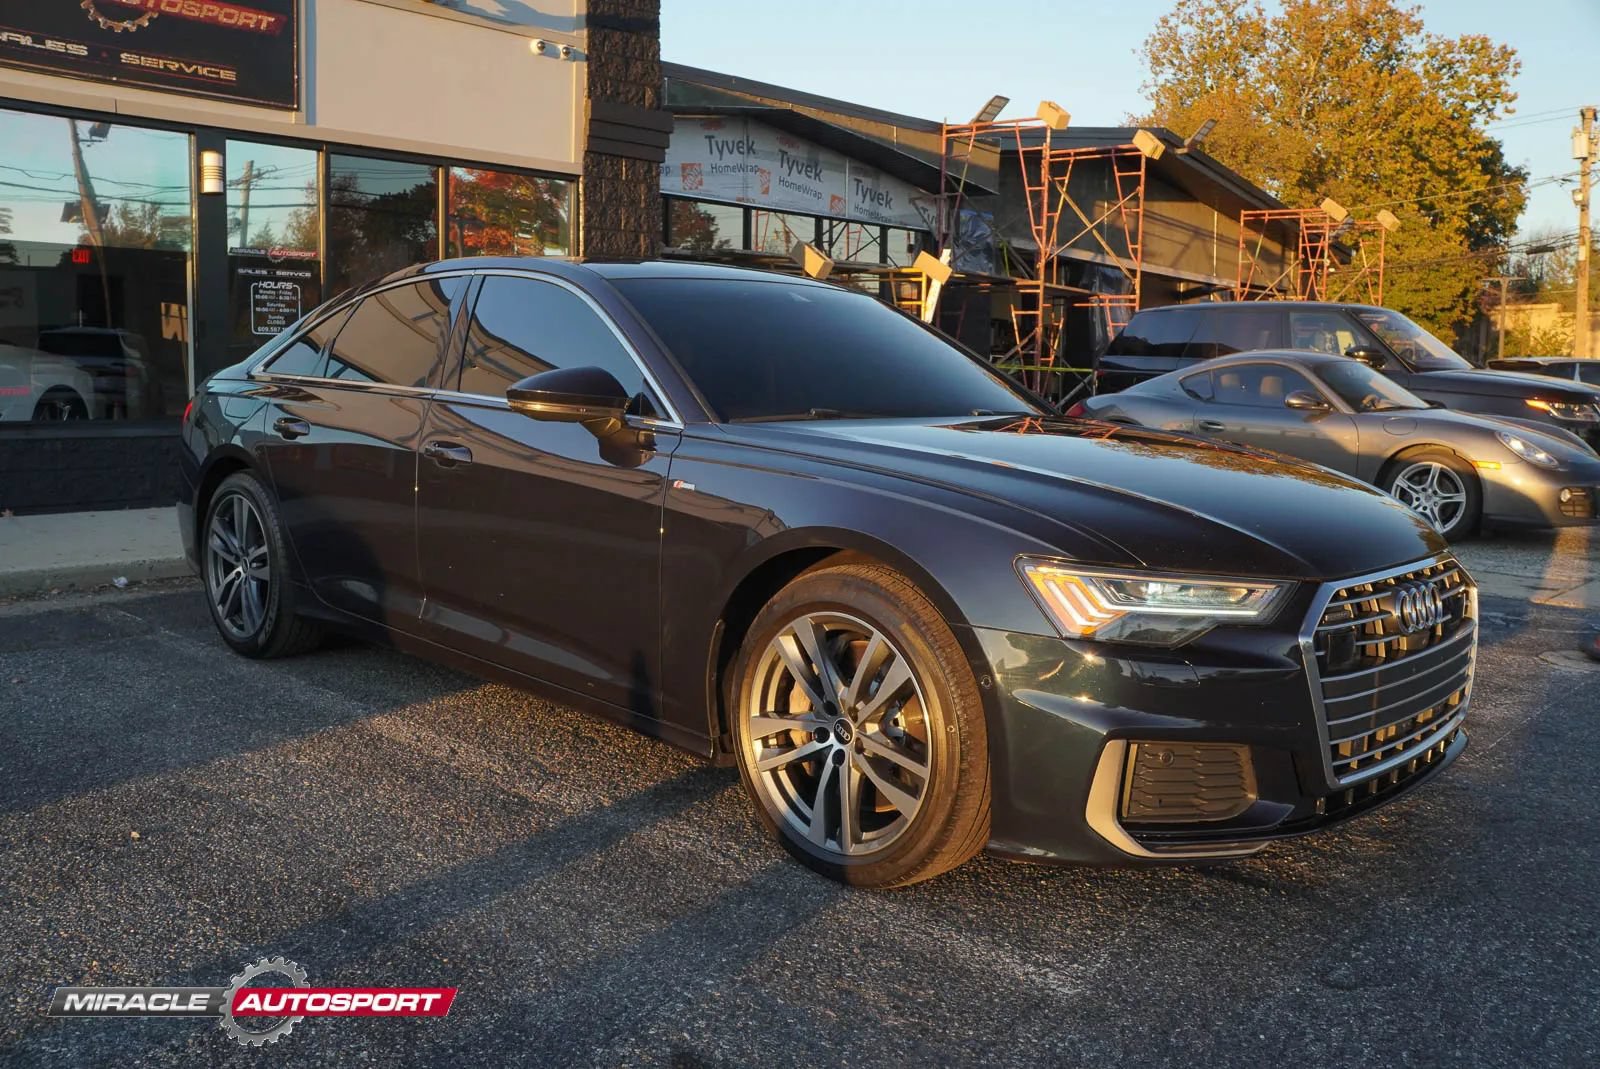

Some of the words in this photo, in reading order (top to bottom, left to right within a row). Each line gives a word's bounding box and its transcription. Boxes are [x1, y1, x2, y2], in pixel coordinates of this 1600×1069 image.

[120, 52, 237, 81] SERVICE
[704, 134, 757, 161] Tyvek
[710, 162, 760, 175] HomeWrap
[778, 148, 824, 183] Tyvek
[778, 175, 823, 201] HomeWrap
[853, 177, 893, 210] Tyvek
[72, 249, 89, 263] EXIT
[258, 281, 294, 290] HOURS
